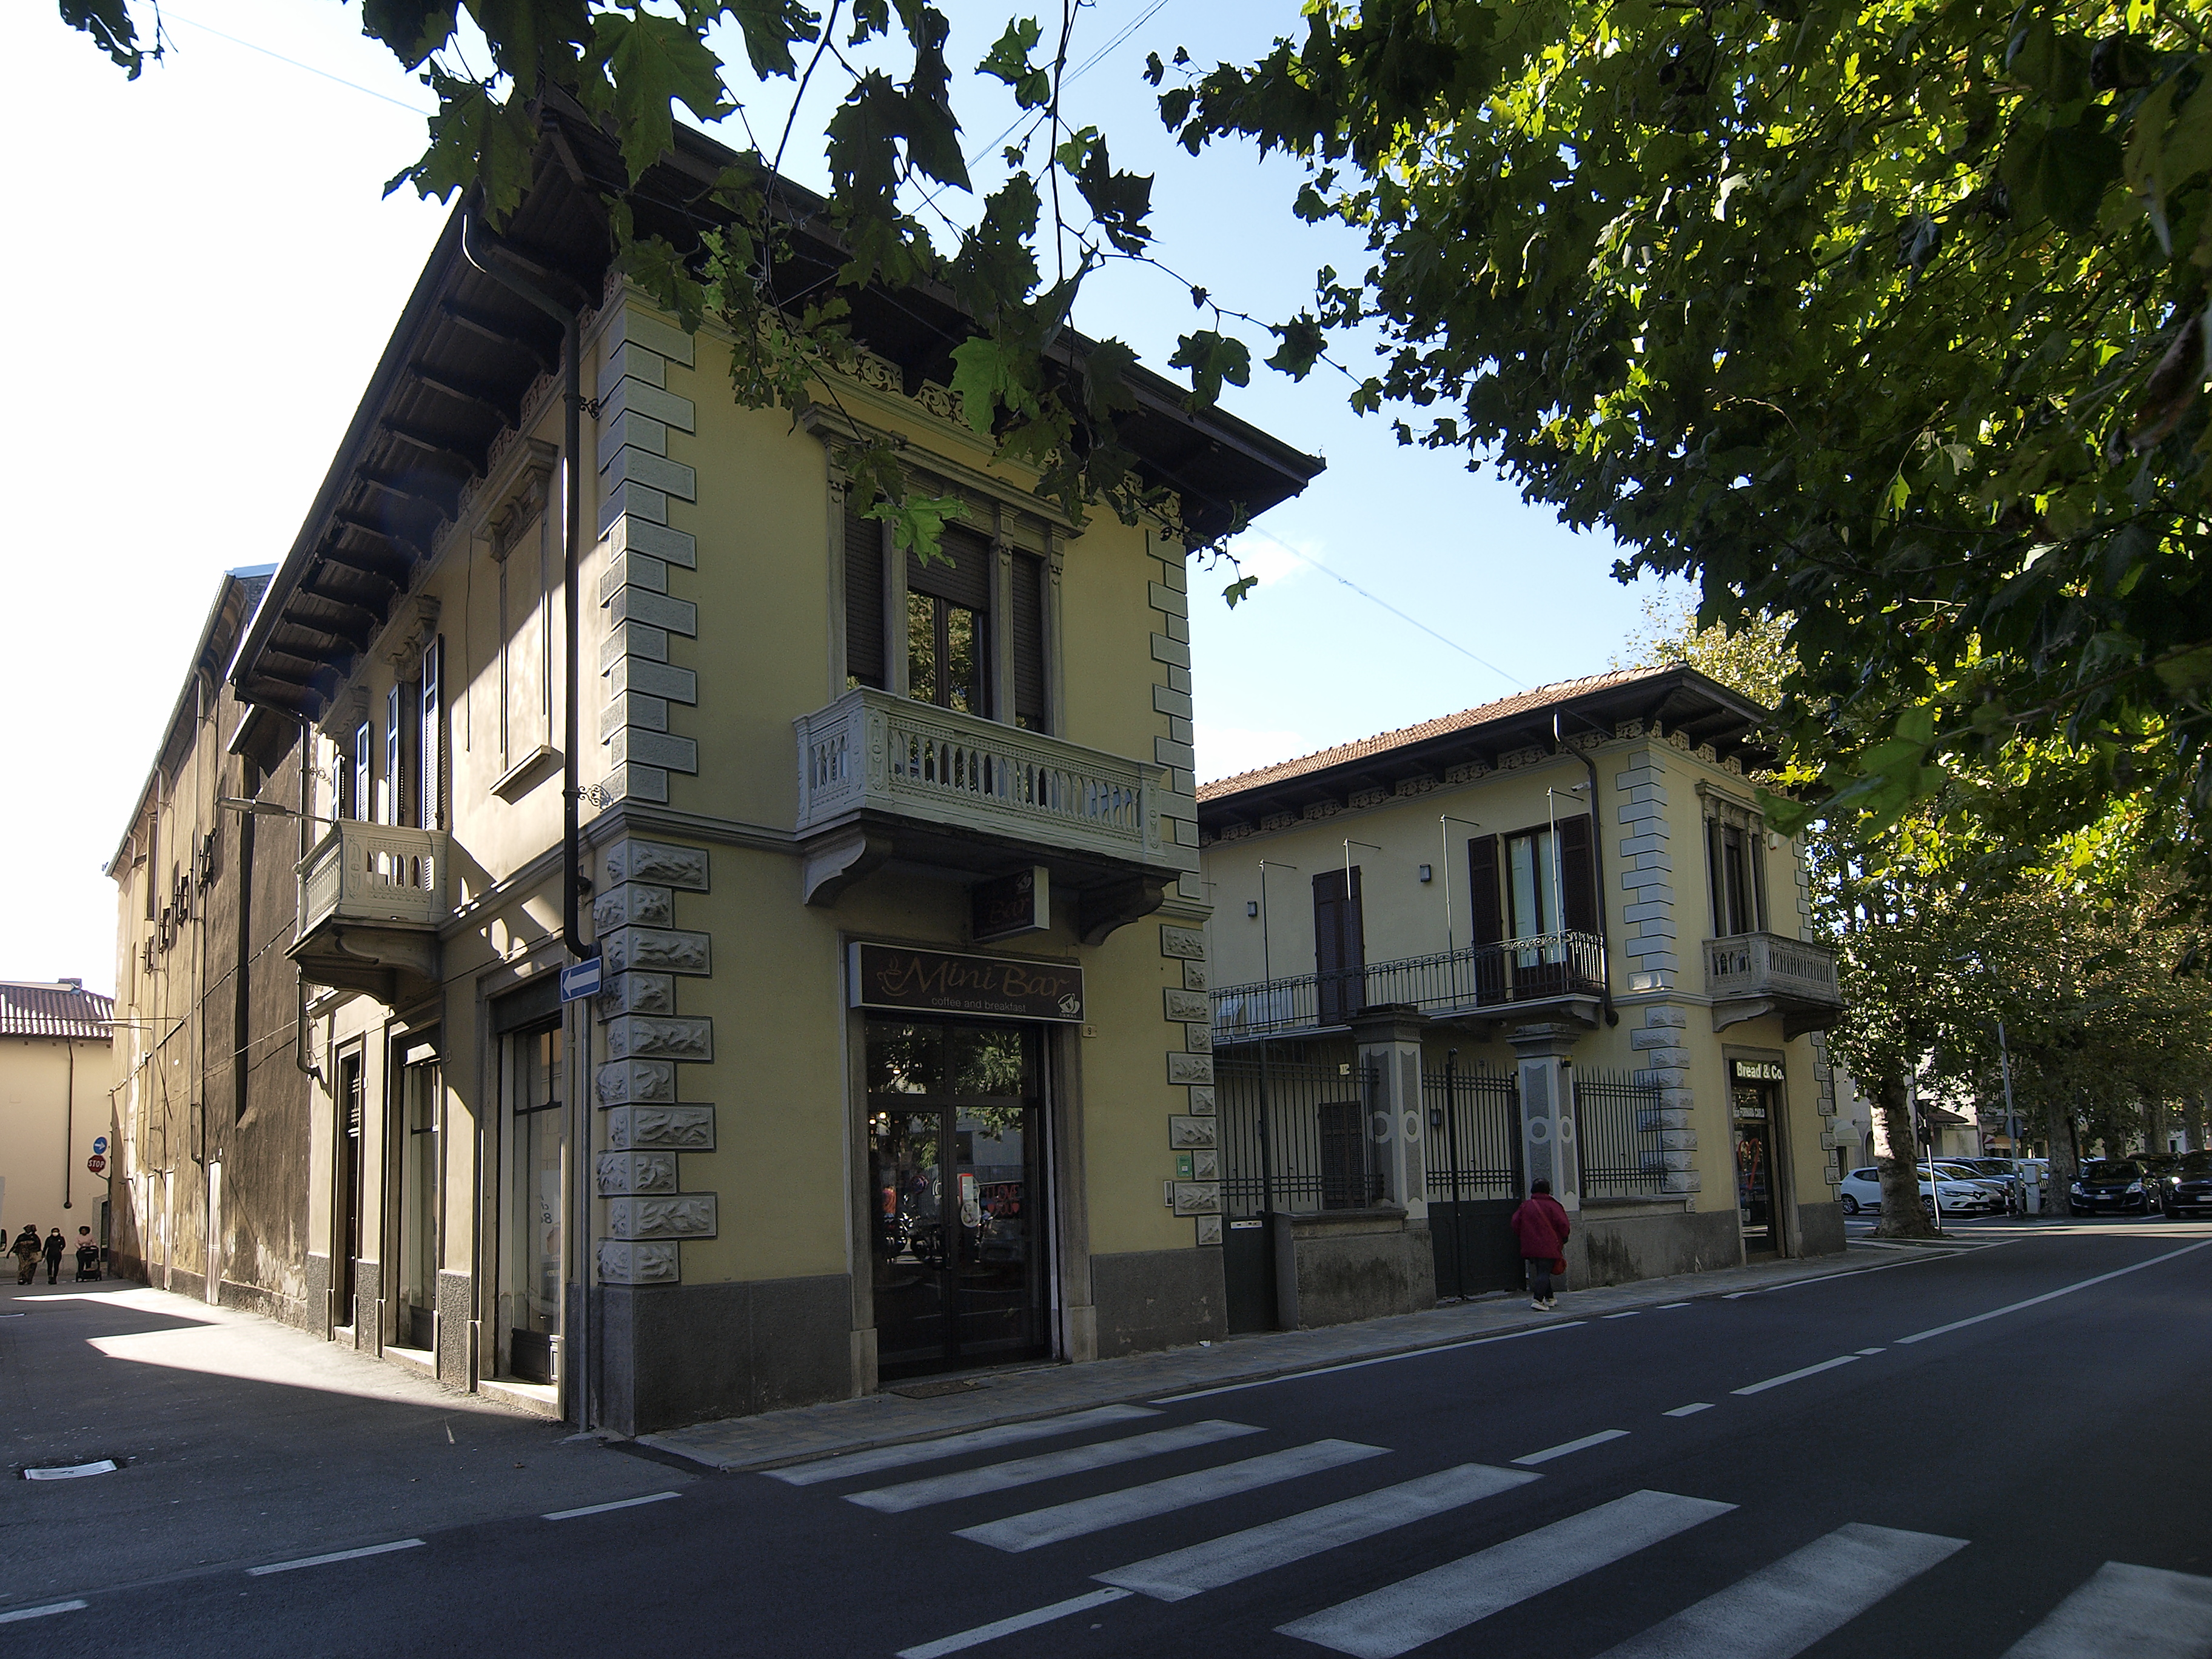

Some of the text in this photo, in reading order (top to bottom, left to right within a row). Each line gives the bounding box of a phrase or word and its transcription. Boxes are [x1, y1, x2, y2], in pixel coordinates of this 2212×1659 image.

[898, 957, 1070, 997] Mini Bar
[931, 996, 1026, 1013] coffee and breakfast
[1736, 1061, 1785, 1080] Bread & Co.
[88, 1159, 105, 1168] STOP
